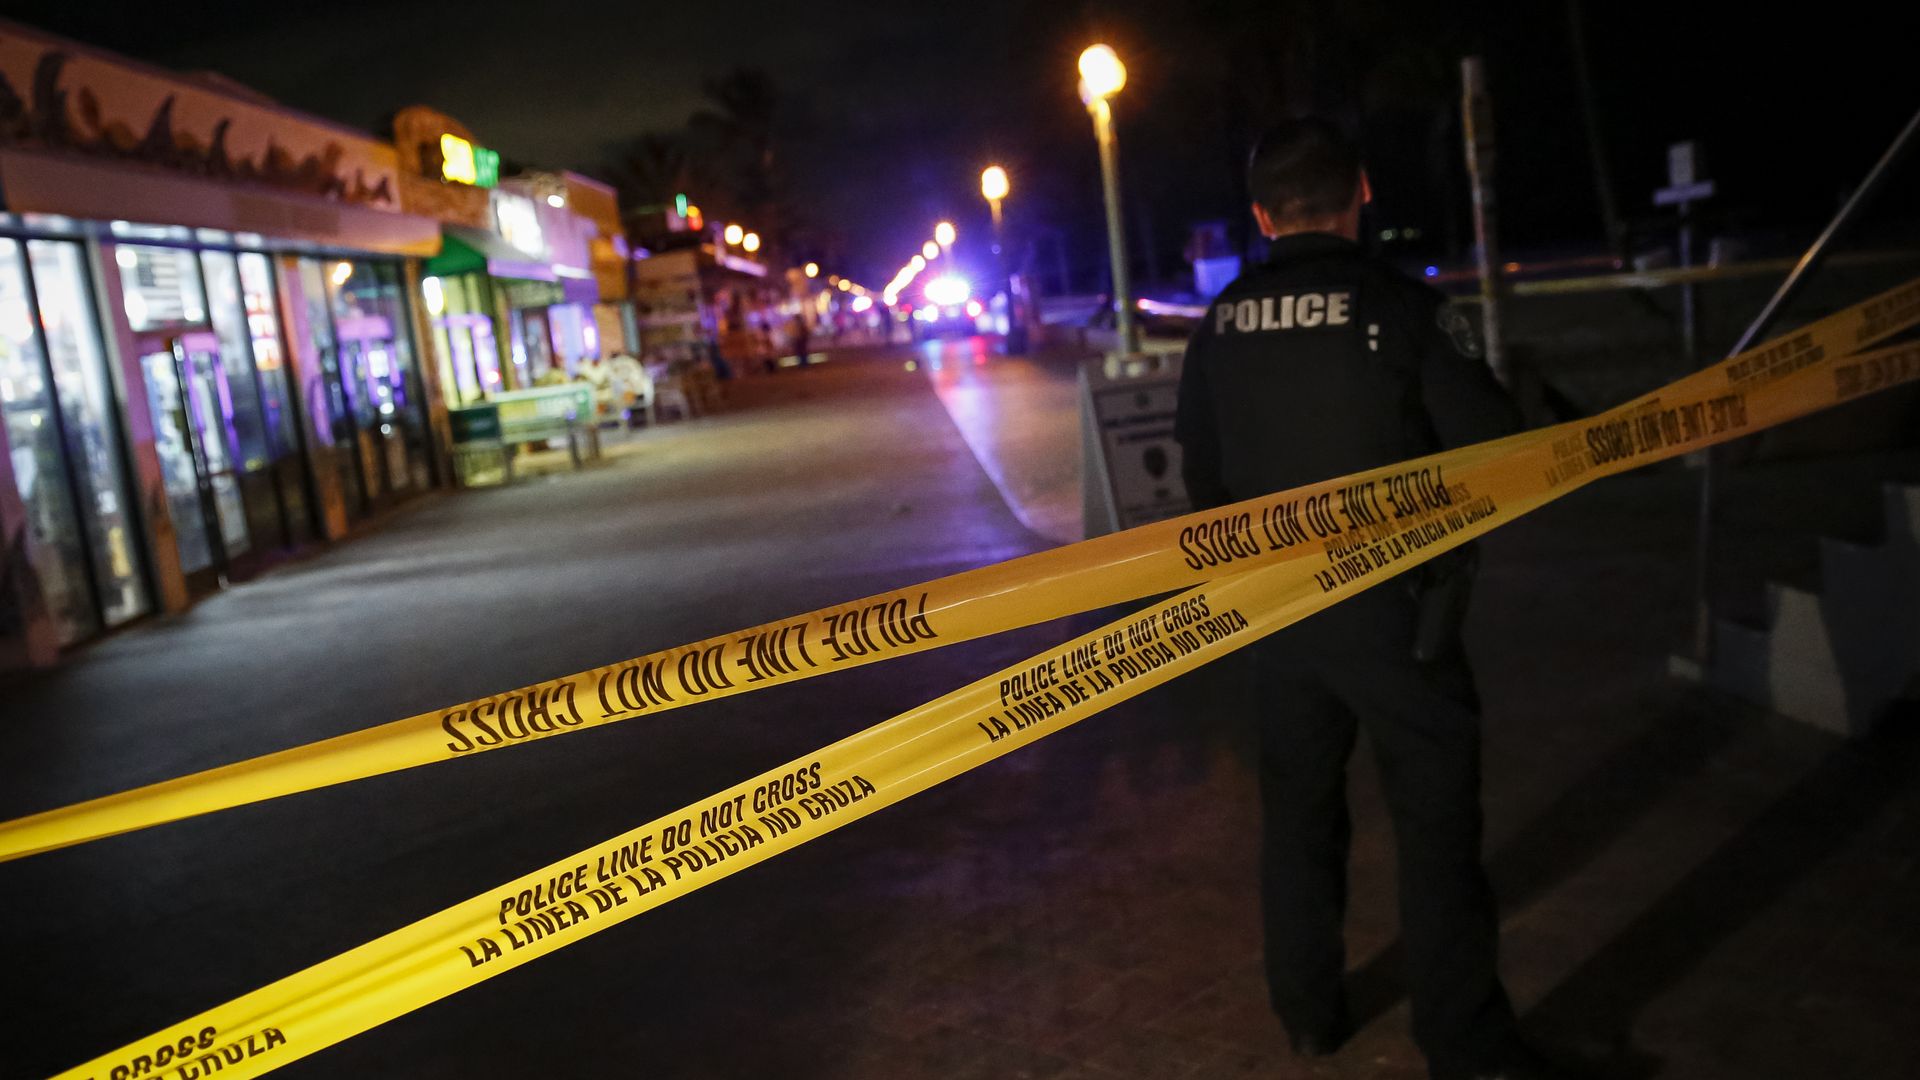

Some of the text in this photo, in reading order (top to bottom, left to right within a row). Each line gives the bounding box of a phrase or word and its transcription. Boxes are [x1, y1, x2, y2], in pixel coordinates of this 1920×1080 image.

[1216, 293, 1349, 334] POLICE
[1587, 418, 1635, 465] CROSS
[1179, 465, 1452, 570] POLICE LINE DO NOT CROSS
[1314, 570, 1337, 593] LA
[1332, 554, 1374, 586] LINEA
[1369, 545, 1390, 568] DE
[1385, 539, 1407, 561] LA
[1401, 518, 1449, 553] POLICIA
[1444, 508, 1464, 533] NO
[441, 592, 938, 753] POLICE LINE DO NOT CROSS
[977, 608, 1249, 743] LA LINEA DE LA POLICIA NO CRUZA
[1000, 594, 1211, 706] POLICE LINE DO NOT CROSS
[459, 775, 877, 968] LA LINEA DE LA POLICIA NO CRUZA
[499, 761, 821, 925] POLICE LINE DO NOT CROSS
